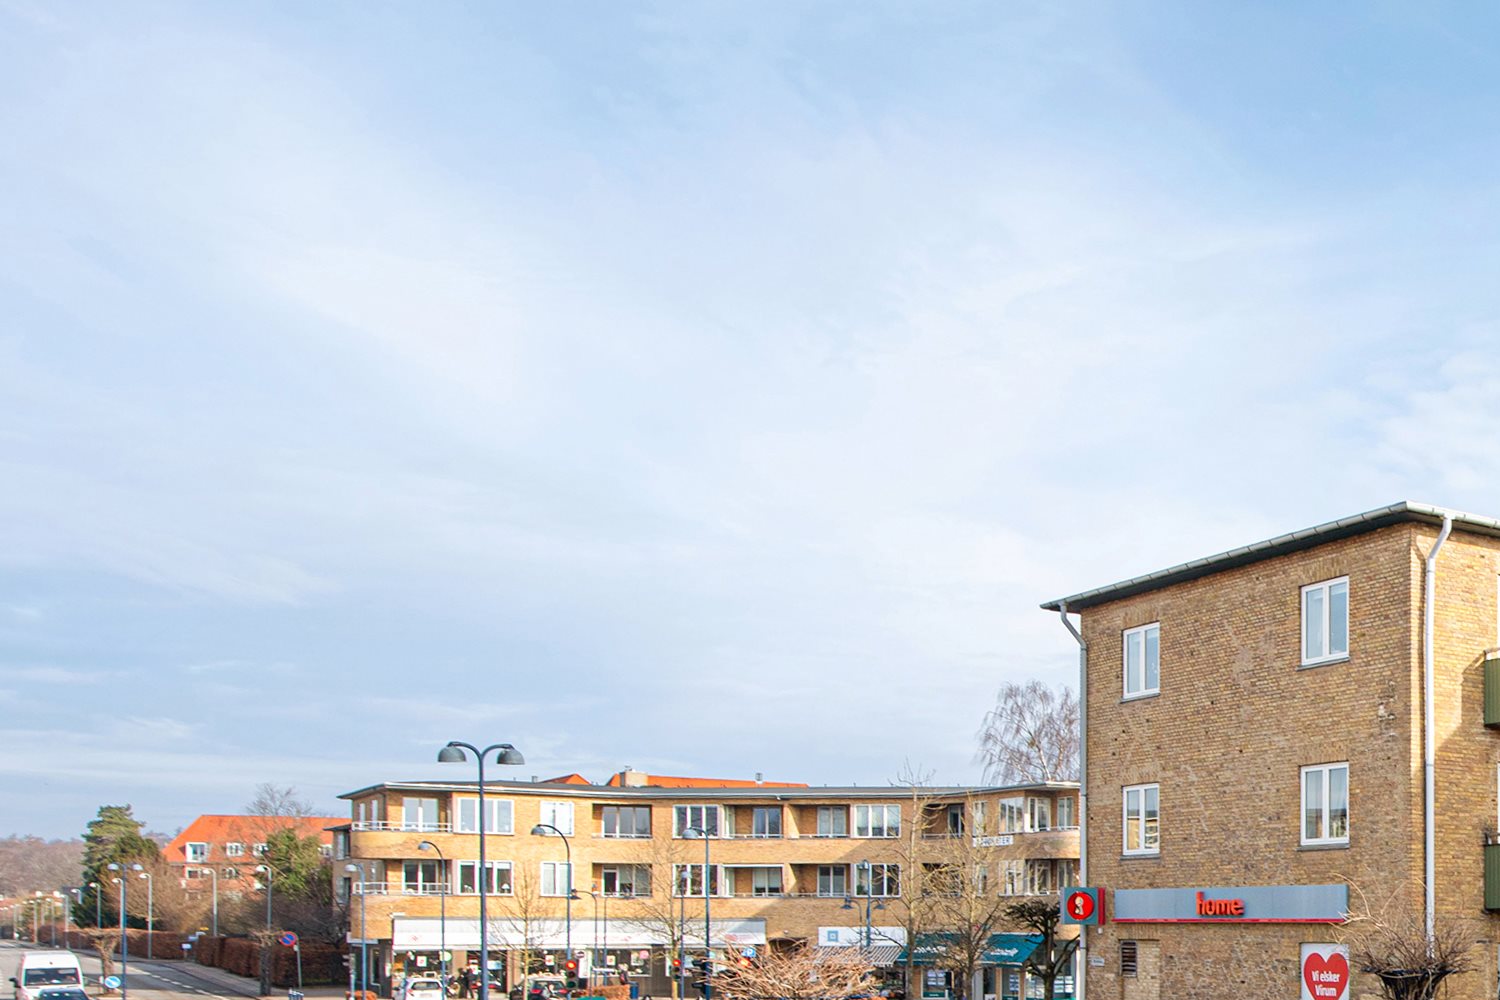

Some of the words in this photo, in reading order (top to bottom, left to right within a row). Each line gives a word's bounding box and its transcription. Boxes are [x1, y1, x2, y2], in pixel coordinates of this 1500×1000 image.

[1196, 891, 1244, 916] home
[1311, 970, 1319, 982] Vi
[1320, 970, 1341, 983] elsker
[1314, 984, 1337, 997] Virum
